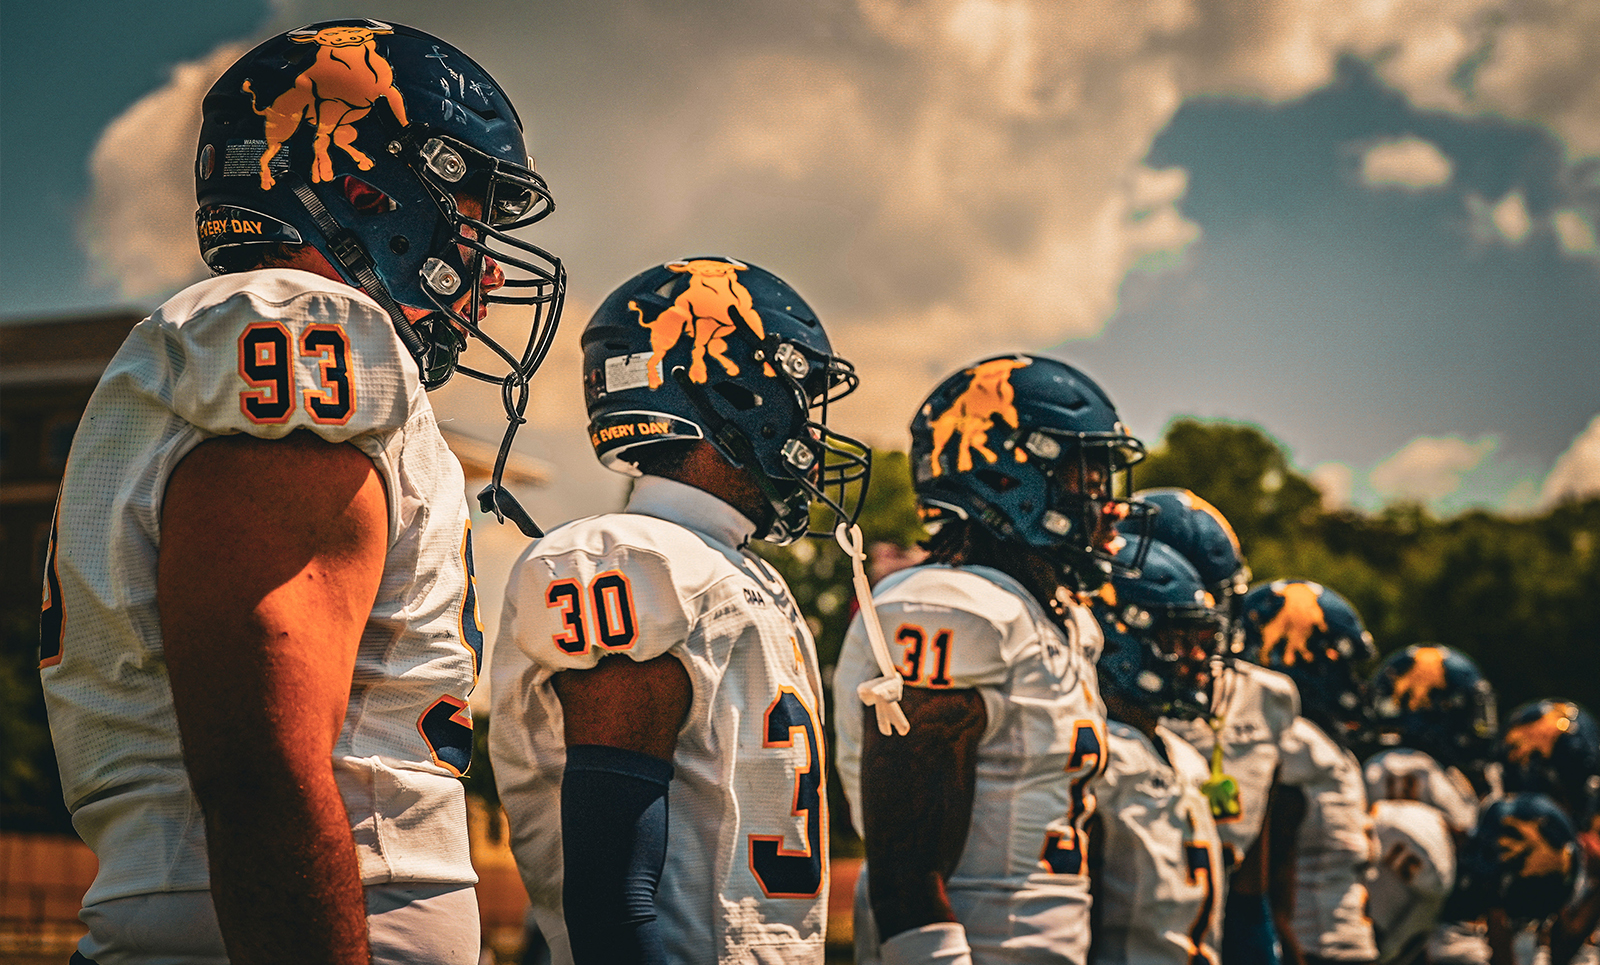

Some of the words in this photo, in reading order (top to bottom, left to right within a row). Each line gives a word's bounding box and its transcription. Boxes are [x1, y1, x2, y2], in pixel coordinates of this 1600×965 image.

[200, 219, 228, 239] EVERY
[231, 219, 262, 235] DAY
[237, 320, 358, 426] 93
[600, 423, 635, 442] EVERY
[638, 422, 669, 435] DAY
[545, 568, 640, 656] 30
[894, 622, 955, 689] 31
[748, 684, 829, 900] 3
